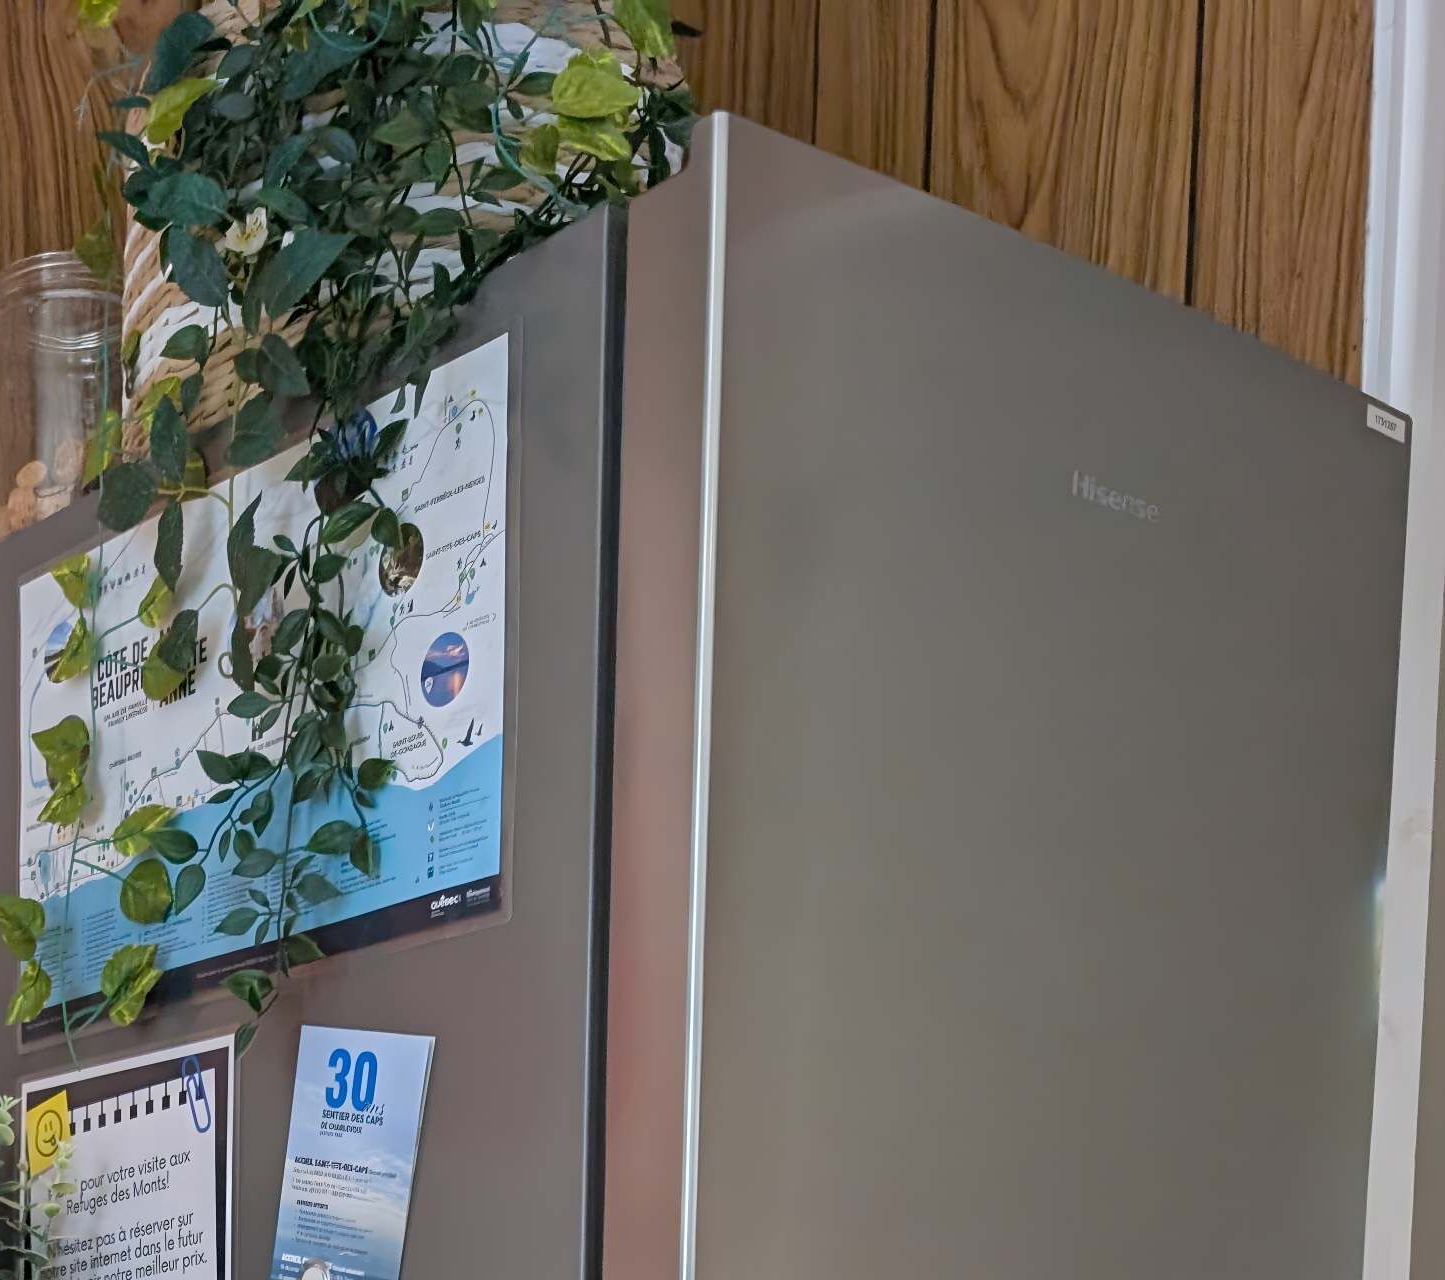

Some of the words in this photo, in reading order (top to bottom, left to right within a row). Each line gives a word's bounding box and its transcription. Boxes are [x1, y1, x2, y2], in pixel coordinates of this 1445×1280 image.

[1071, 469, 1161, 523] Hisense
[132, 637, 148, 666] DE
[92, 667, 144, 711] BEAUPR
[325, 1048, 378, 1111] 30
[322, 1109, 350, 1121] SENTIER
[351, 1111, 365, 1124] DES
[365, 1114, 384, 1127] CAPS
[66, 1195, 109, 1216] Refuges
[110, 1184, 130, 1205] des
[133, 1171, 170, 1198] Monts!
[80, 1174, 105, 1201] pour
[107, 1166, 136, 1185] votre
[138, 1156, 167, 1176] visite
[169, 1150, 192, 1168] aux
[69, 1257, 88, 1275] site
[90, 1247, 132, 1271] internet
[135, 1238, 162, 1259] dans
[164, 1231, 176, 1252] le
[178, 1229, 205, 1249] futur
[96, 1233, 116, 1253] pas
[118, 1226, 127, 1243] à
[129, 1216, 176, 1240] réserver
[177, 1211, 195, 1229] sur
[135, 1254, 180, 1280] meilleur
[181, 1250, 209, 1275] prix.
